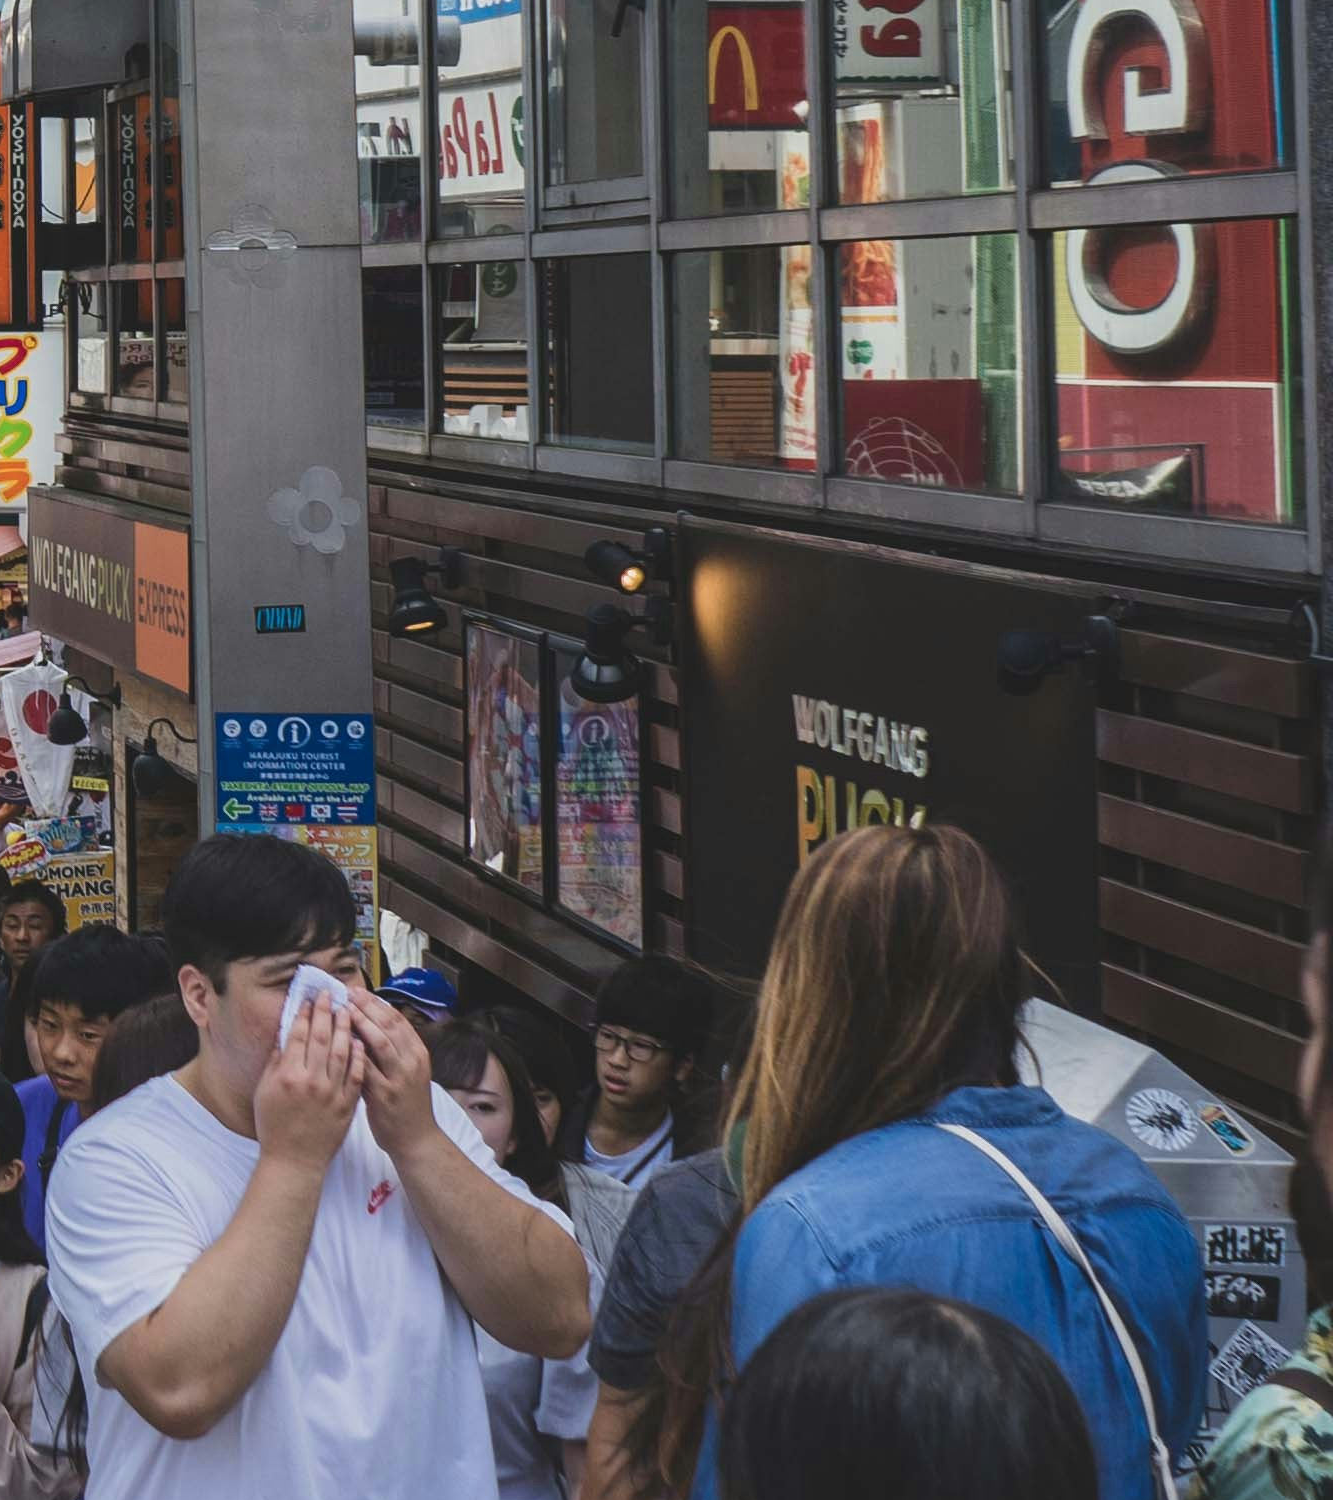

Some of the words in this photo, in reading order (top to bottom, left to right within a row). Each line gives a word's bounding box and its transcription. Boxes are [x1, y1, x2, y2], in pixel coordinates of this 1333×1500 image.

[12, 113, 25, 228] YOSHINOYA
[31, 535, 97, 609] WOLFGANG
[97, 557, 133, 623] PUCK
[138, 577, 185, 638] EXPRESS
[243, 761, 308, 771] INFORMATION
[310, 761, 346, 771] CENTER
[249, 751, 299, 760] HARAJUKU
[301, 751, 340, 760] TOURIST
[792, 694, 929, 778] WOLFGANG
[48, 864, 107, 880] MONEY
